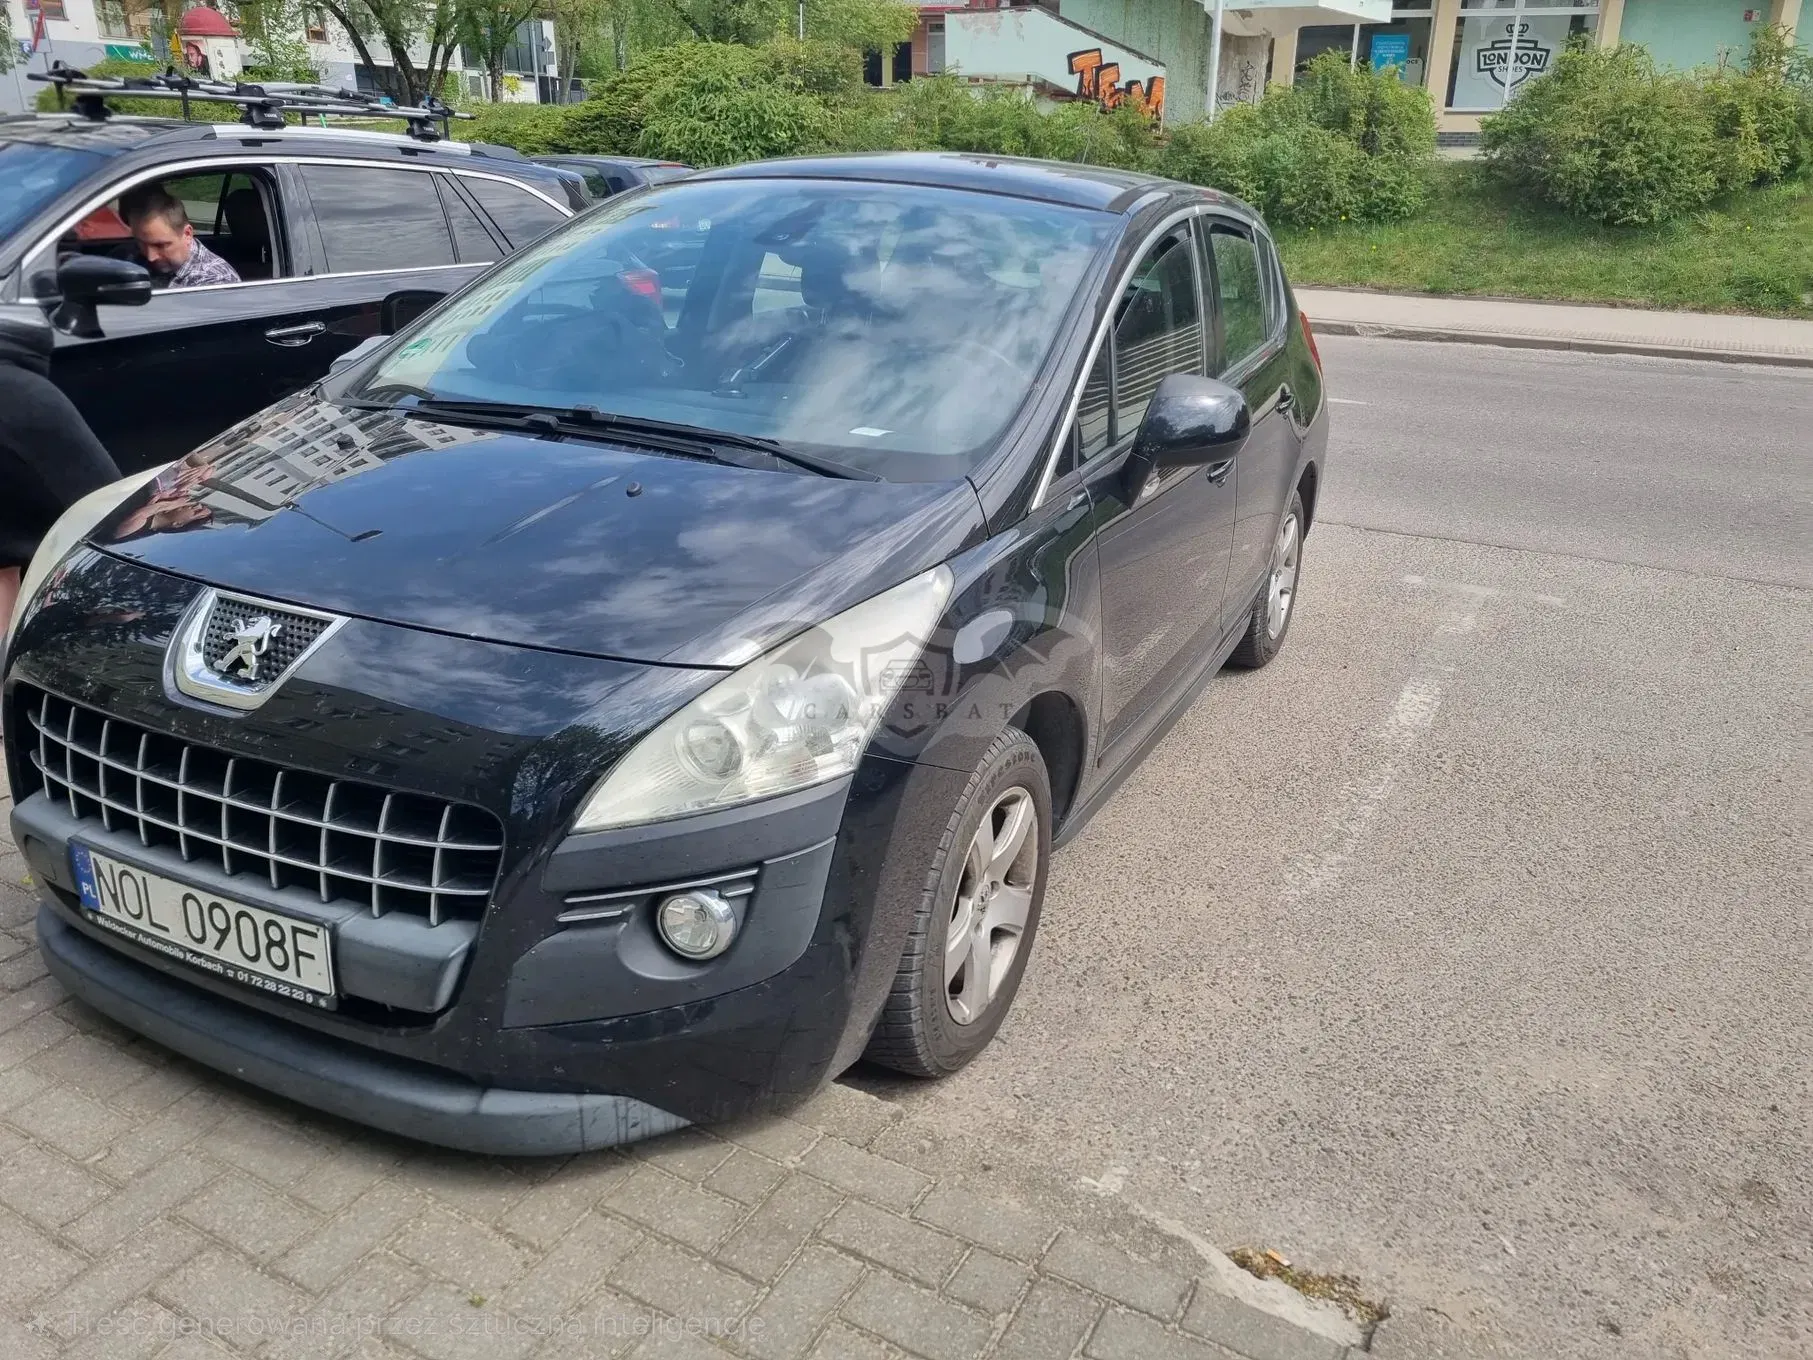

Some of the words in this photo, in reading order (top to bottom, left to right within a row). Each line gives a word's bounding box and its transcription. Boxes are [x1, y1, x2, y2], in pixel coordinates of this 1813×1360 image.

[81, 881, 96, 899] PL
[92, 857, 170, 933] NOL
[181, 892, 319, 979] 0908F
[96, 915, 137, 939] Waldecker
[137, 933, 185, 960] Automobile
[185, 952, 223, 974] Korbach
[237, 971, 249, 983] 01
[251, 975, 263, 988] 72
[306, 993, 314, 1004] 9
